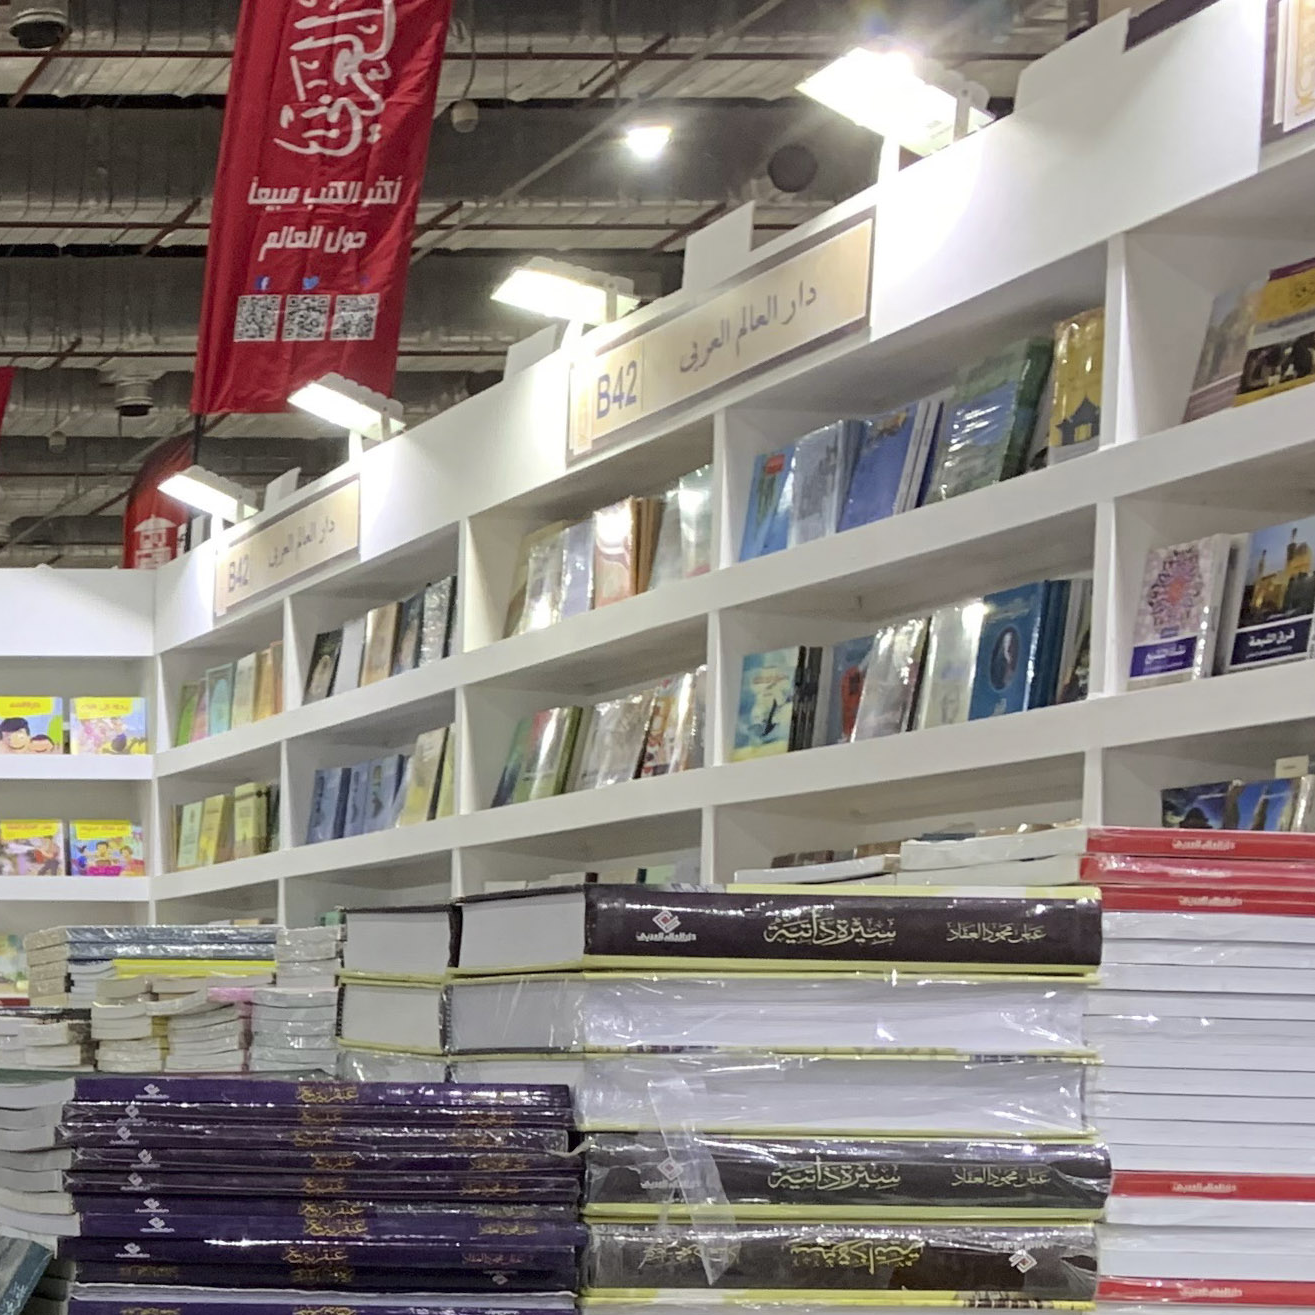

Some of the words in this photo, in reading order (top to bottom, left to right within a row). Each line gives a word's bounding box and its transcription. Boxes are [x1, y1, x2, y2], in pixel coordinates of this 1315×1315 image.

[302, 181, 363, 211] الكتب
[361, 175, 403, 207] أكثر
[258, 225, 324, 262] العالم
[324, 225, 368, 254] حول
[781, 280, 817, 326] دار
[736, 295, 778, 357] العالم
[597, 359, 637, 419] B42
[229, 554, 249, 592] B42
[764, 907, 834, 945] ذاتية
[822, 916, 897, 945] سيرة
